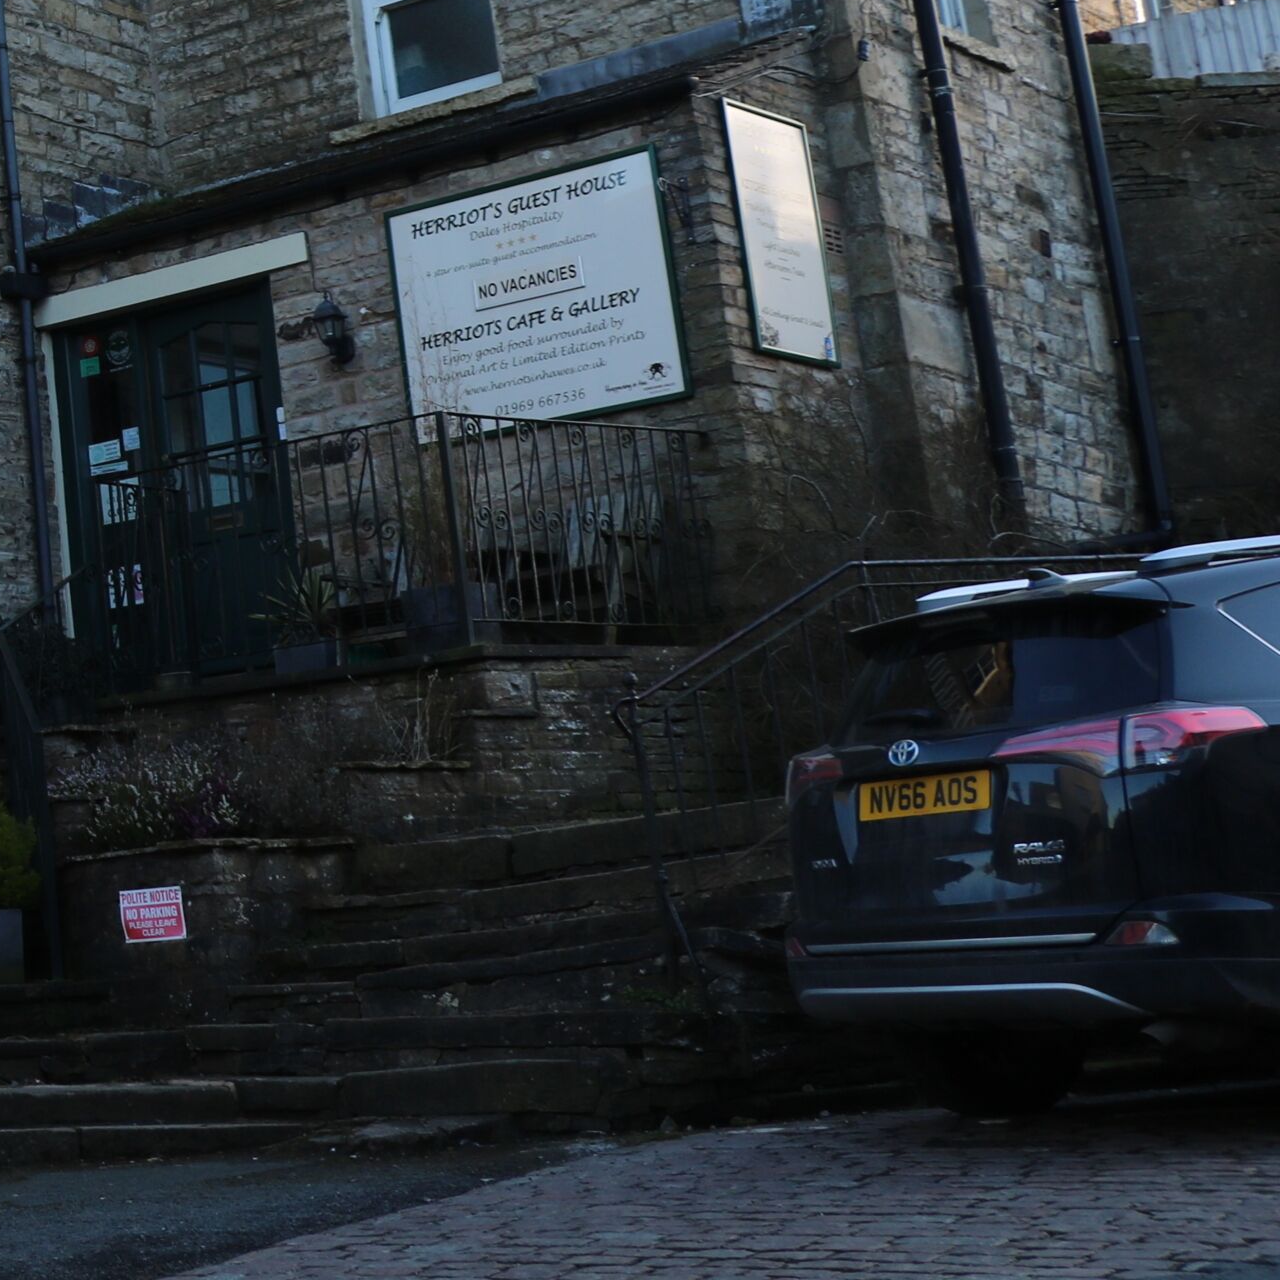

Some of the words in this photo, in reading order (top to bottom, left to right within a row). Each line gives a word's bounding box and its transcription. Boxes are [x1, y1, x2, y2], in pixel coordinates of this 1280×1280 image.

[410, 201, 503, 240] HERRIOT'S
[507, 185, 561, 215] GUEST
[565, 170, 628, 200] HOUSE
[470, 226, 500, 241] Dales
[502, 210, 564, 233] Hospitality
[493, 249, 517, 266] guest
[518, 230, 597, 257] accommodation
[478, 281, 498, 300] NO
[502, 263, 577, 294] VACANCIES
[420, 318, 502, 351] HERRIOTS
[506, 308, 546, 335] CAFE
[550, 306, 564, 322] &
[568, 287, 640, 318] GALLERY
[426, 365, 476, 386] Original
[478, 361, 498, 374] Art
[500, 360, 509, 370] &
[512, 348, 558, 367] Limited
[560, 338, 606, 357] Edition
[608, 330, 646, 347] Prints
[442, 350, 473, 367] Enjoy
[475, 341, 505, 361] good
[506, 335, 534, 353] food
[537, 318, 608, 346] surrounded
[610, 316, 624, 330] by
[494, 397, 535, 418] 01969
[538, 387, 586, 409] 667536
[869, 781, 927, 814] NV66
[933, 775, 978, 806] AOS
[120, 891, 147, 905] POLITE
[149, 888, 180, 902] NOTICE
[126, 908, 138, 921] NO
[140, 905, 178, 920] PARKING
[128, 920, 154, 929] PLEASE
[154, 918, 177, 927] LEAVE
[142, 927, 165, 937] CLEAR
